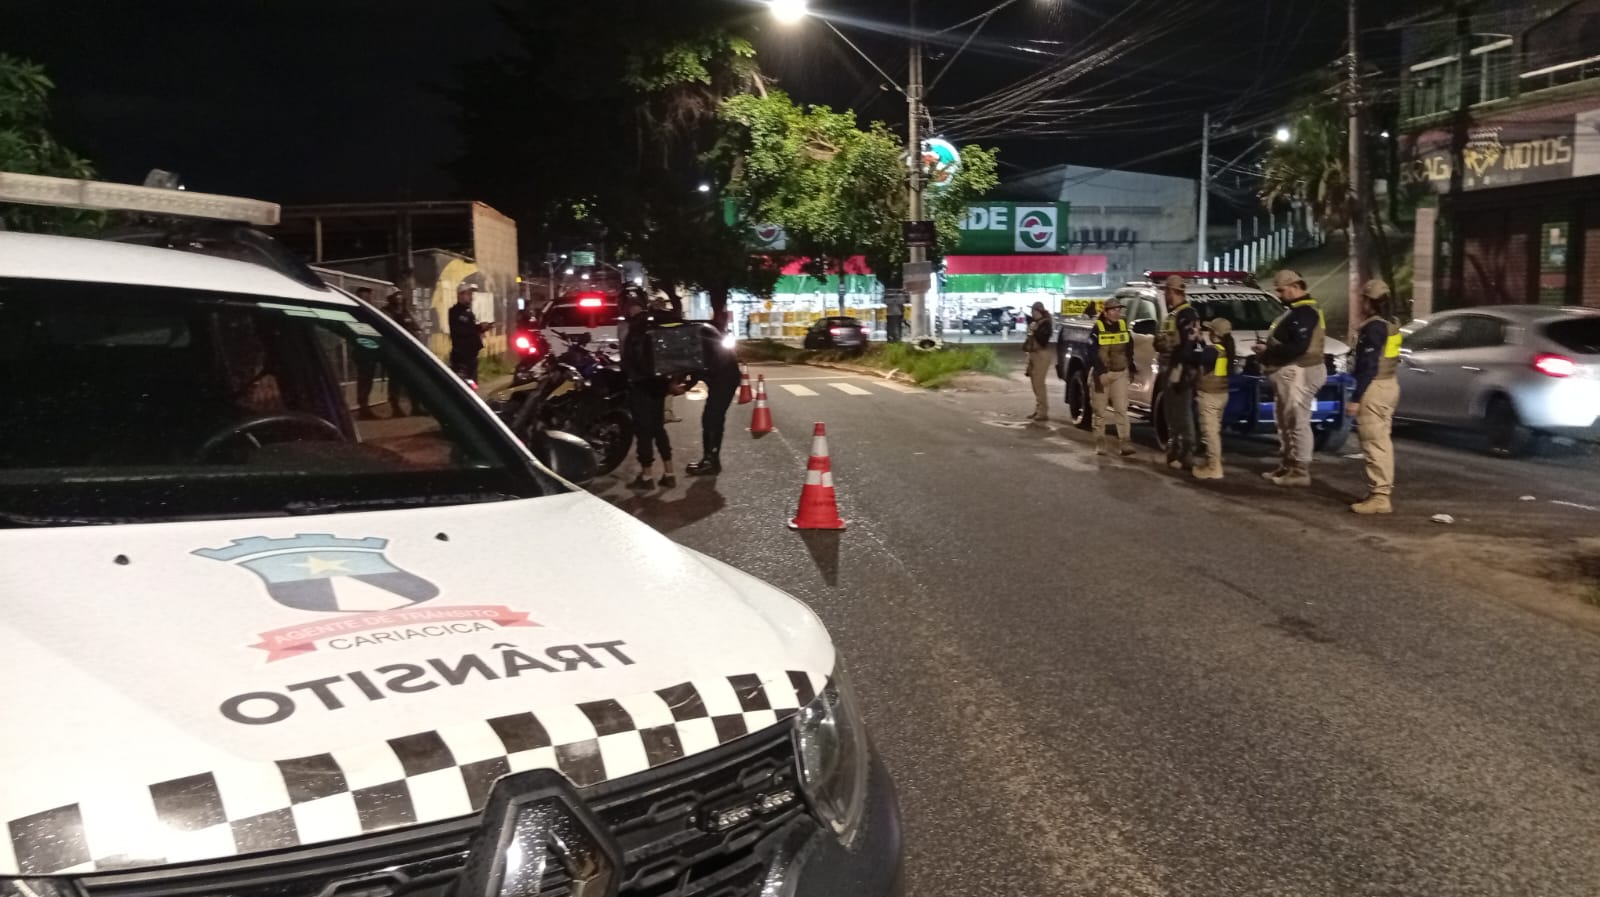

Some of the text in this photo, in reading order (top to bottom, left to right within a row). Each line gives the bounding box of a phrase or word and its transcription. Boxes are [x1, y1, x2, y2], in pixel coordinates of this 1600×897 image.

[1503, 136, 1571, 170] MOTOS
[275, 620, 355, 645] AGENTE
[364, 612, 388, 628] DE
[328, 621, 495, 650] CARIACICA
